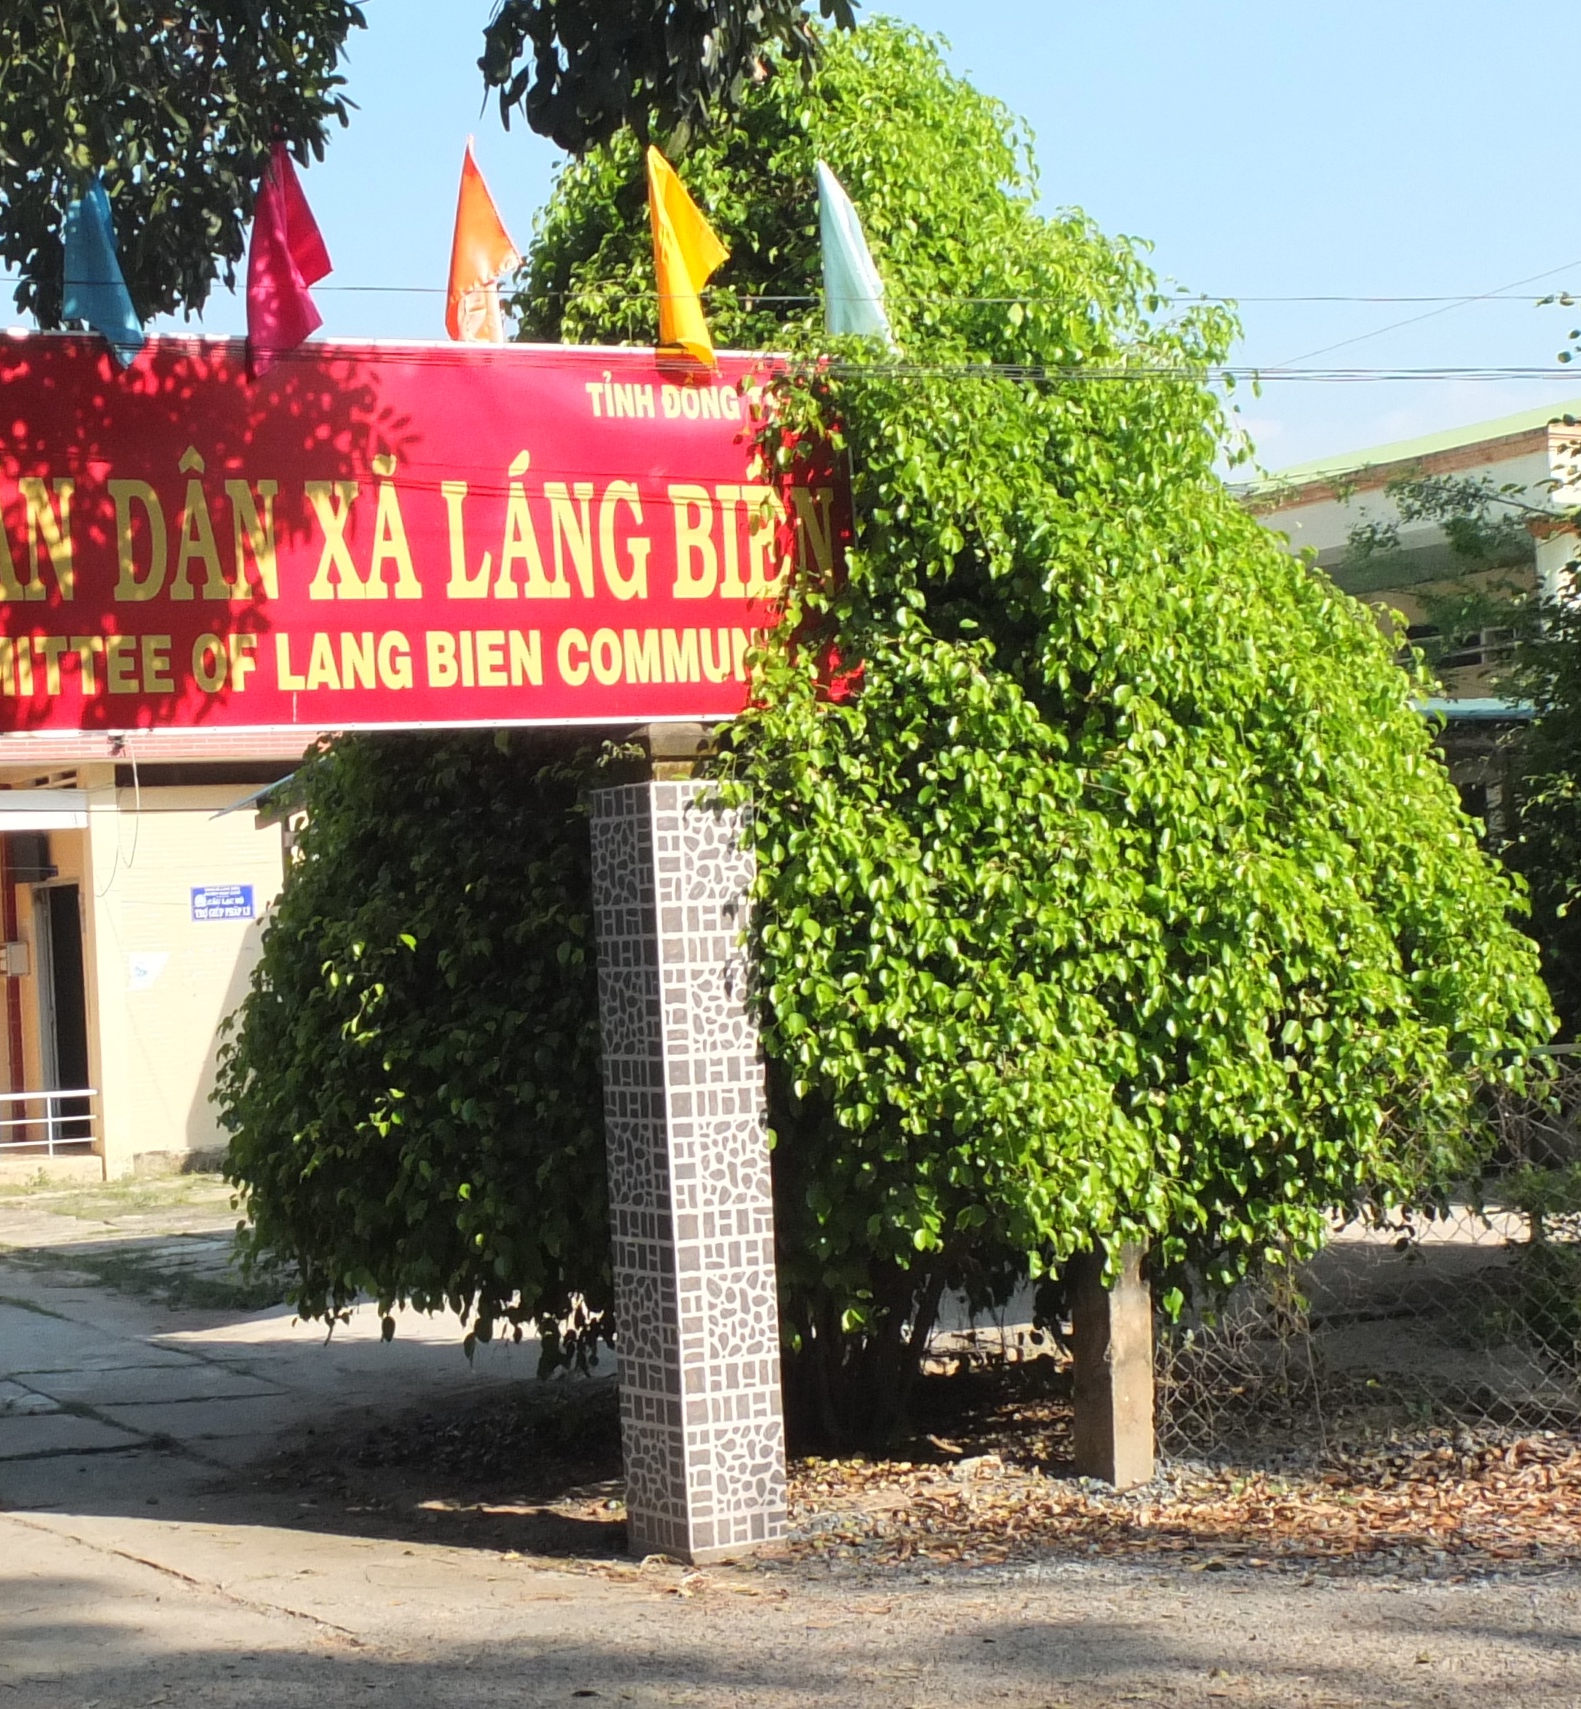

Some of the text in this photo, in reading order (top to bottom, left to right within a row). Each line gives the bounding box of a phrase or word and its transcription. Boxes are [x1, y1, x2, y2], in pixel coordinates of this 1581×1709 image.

[585, 371, 655, 418] TỈNH
[110, 445, 280, 602] DÂN
[305, 454, 423, 601] XÃ
[441, 450, 652, 601] LÁNG
[192, 633, 258, 694] OF
[275, 630, 414, 692] LANG
[426, 629, 544, 688] BIEN
